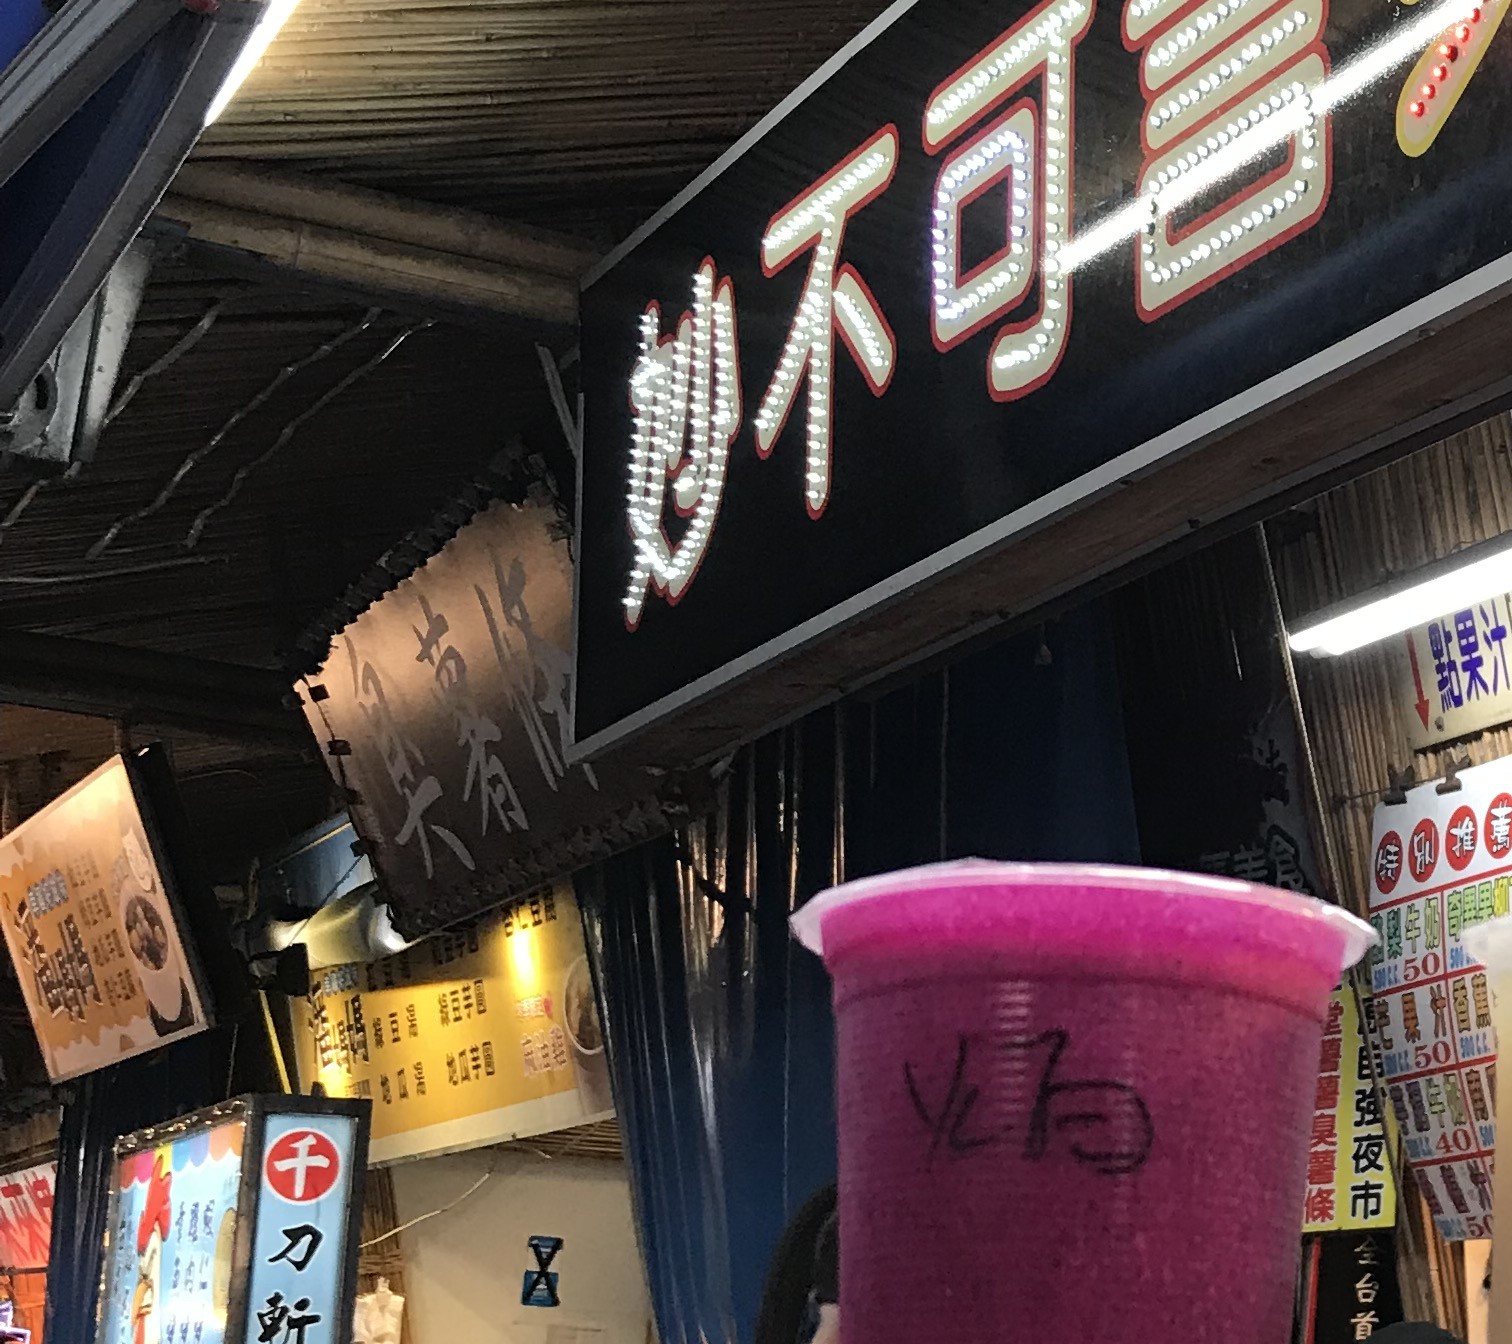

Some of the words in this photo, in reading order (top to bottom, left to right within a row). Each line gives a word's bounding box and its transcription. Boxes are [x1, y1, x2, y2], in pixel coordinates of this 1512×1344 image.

[1428, 599, 1511, 714] 點果汁
[1403, 952, 1441, 982] 50
[1414, 1040, 1451, 1069] 50
[1435, 1128, 1472, 1154] 40
